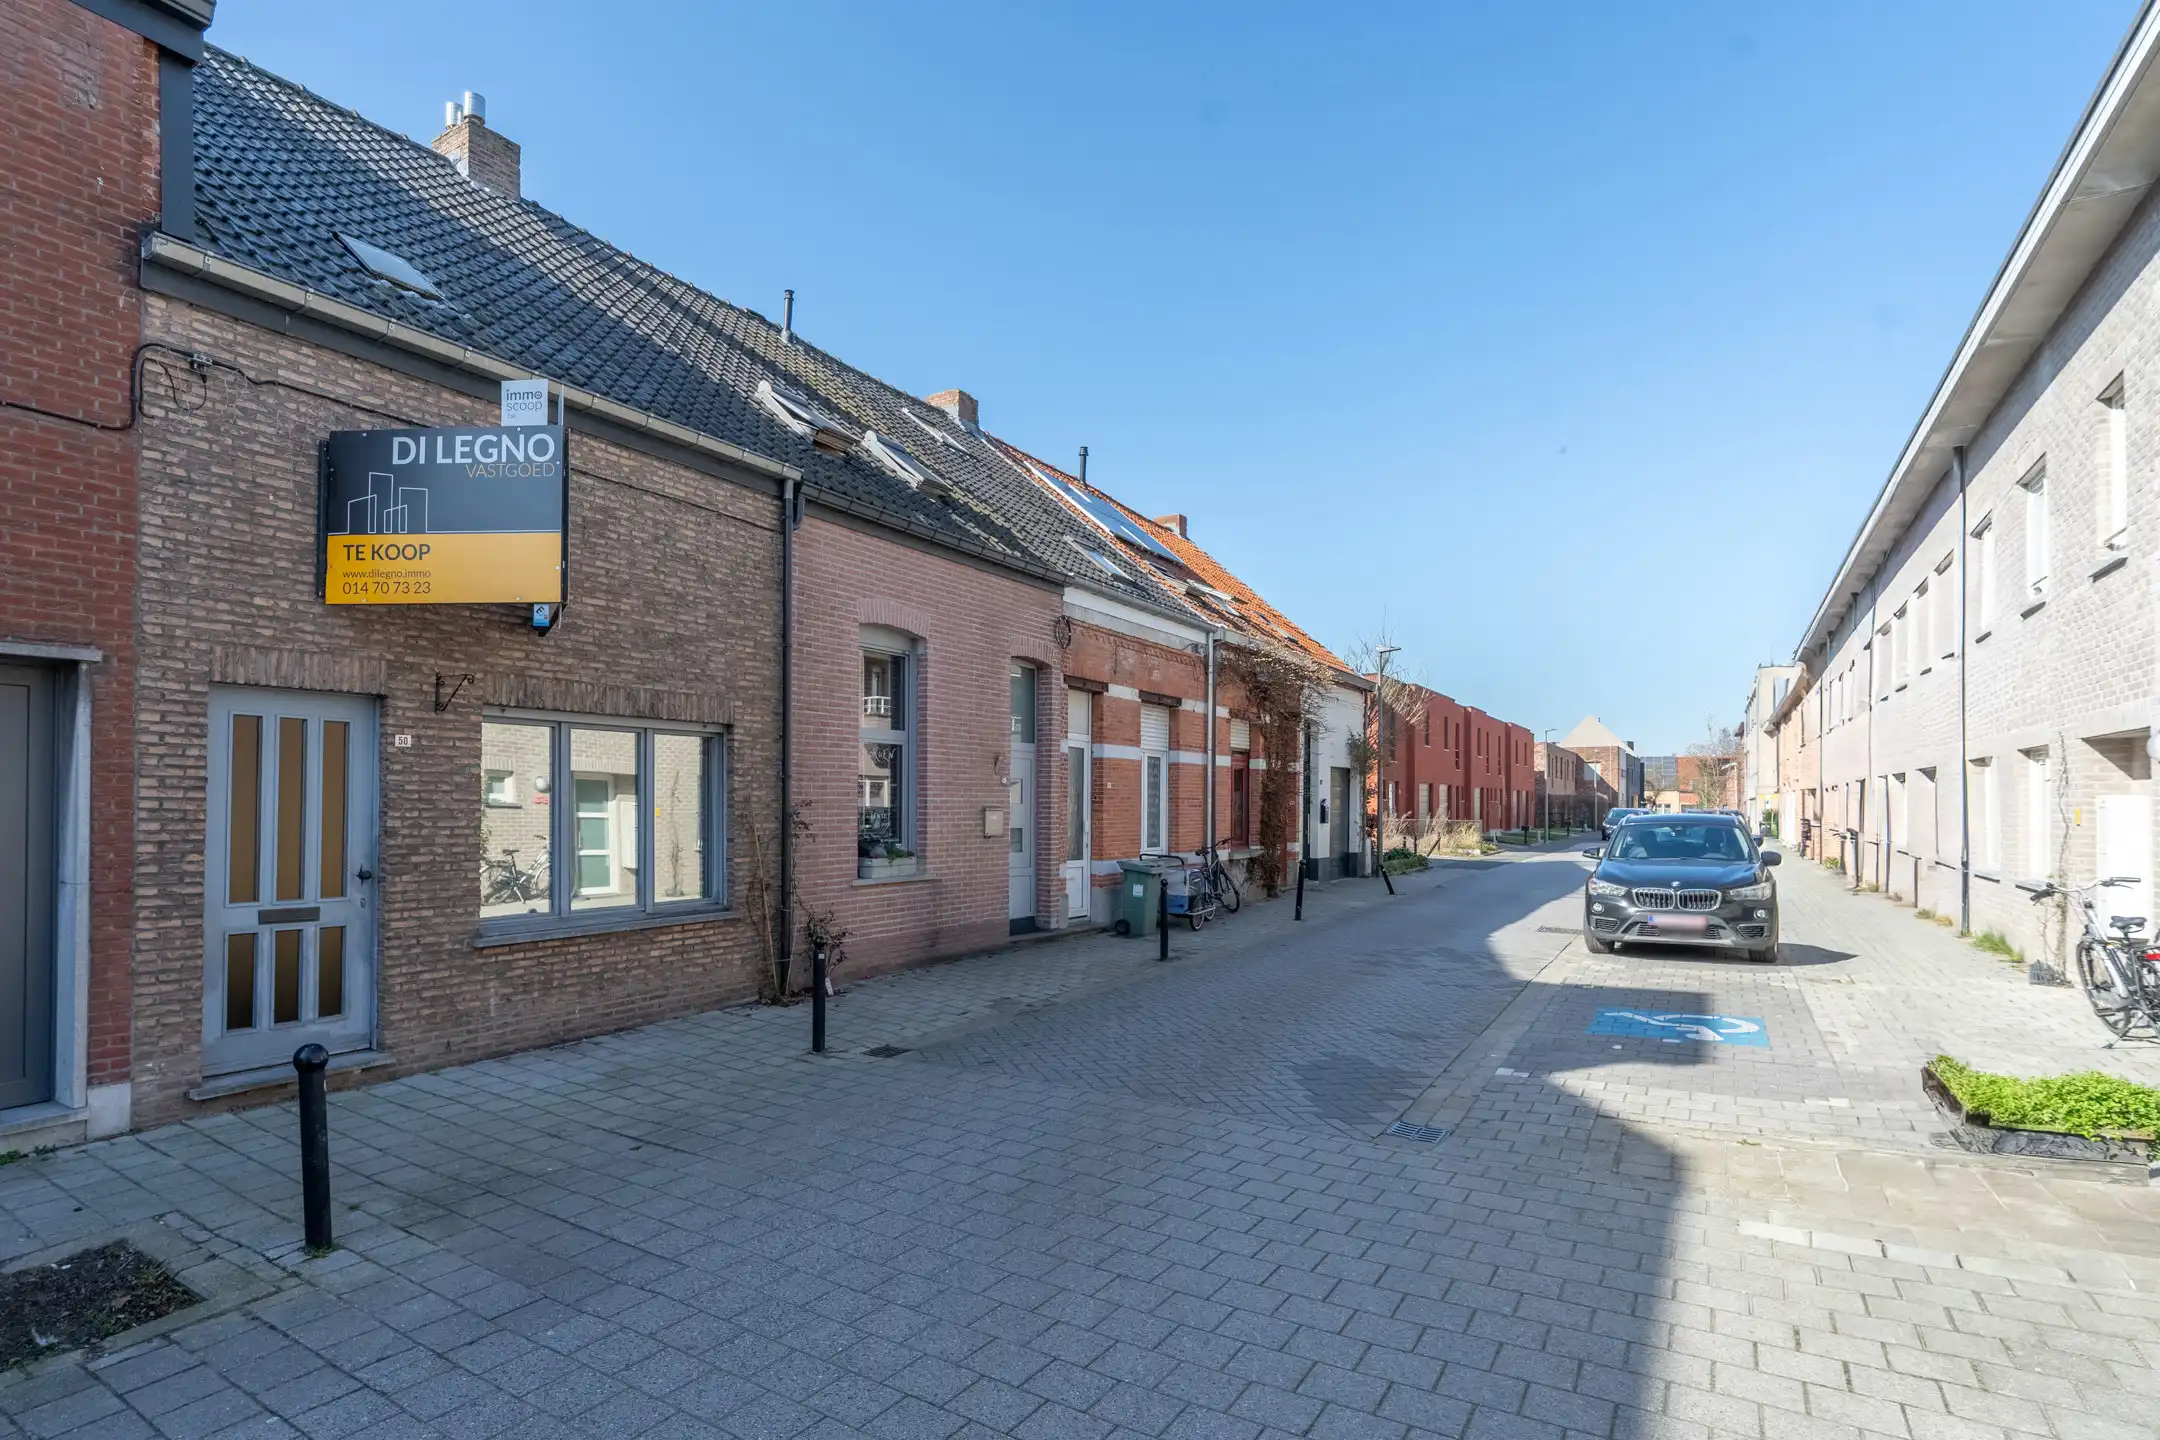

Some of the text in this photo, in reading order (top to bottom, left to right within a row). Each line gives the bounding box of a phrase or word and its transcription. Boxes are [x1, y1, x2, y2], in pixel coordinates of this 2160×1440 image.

[506, 389, 542, 400] immo
[506, 402, 542, 412] scoop
[392, 433, 555, 464] DI LEGNO
[465, 463, 555, 478] VASTGOED
[343, 544, 430, 561] TE KOOP
[342, 569, 431, 579] www.dilegno.immo
[342, 582, 431, 595] 014 70 73 23
[398, 736, 408, 745] 50
